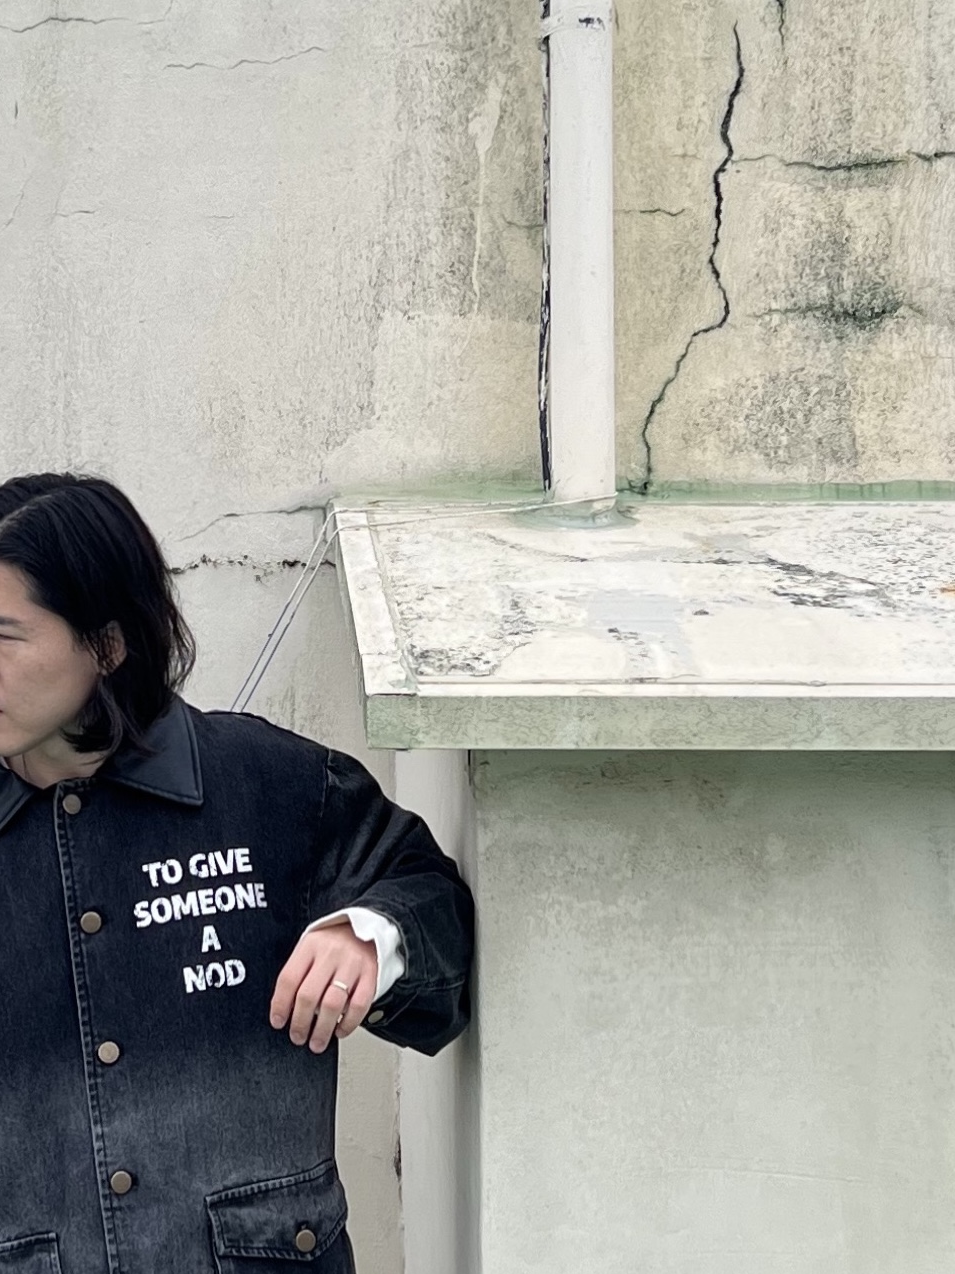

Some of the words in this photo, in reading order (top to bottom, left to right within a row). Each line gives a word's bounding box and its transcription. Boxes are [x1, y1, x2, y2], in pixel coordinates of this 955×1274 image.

[142, 859, 183, 887] TO
[189, 848, 253, 878] GIVE
[133, 883, 268, 928] SOMEONE
[201, 925, 222, 952] A
[183, 959, 246, 993] NOD
